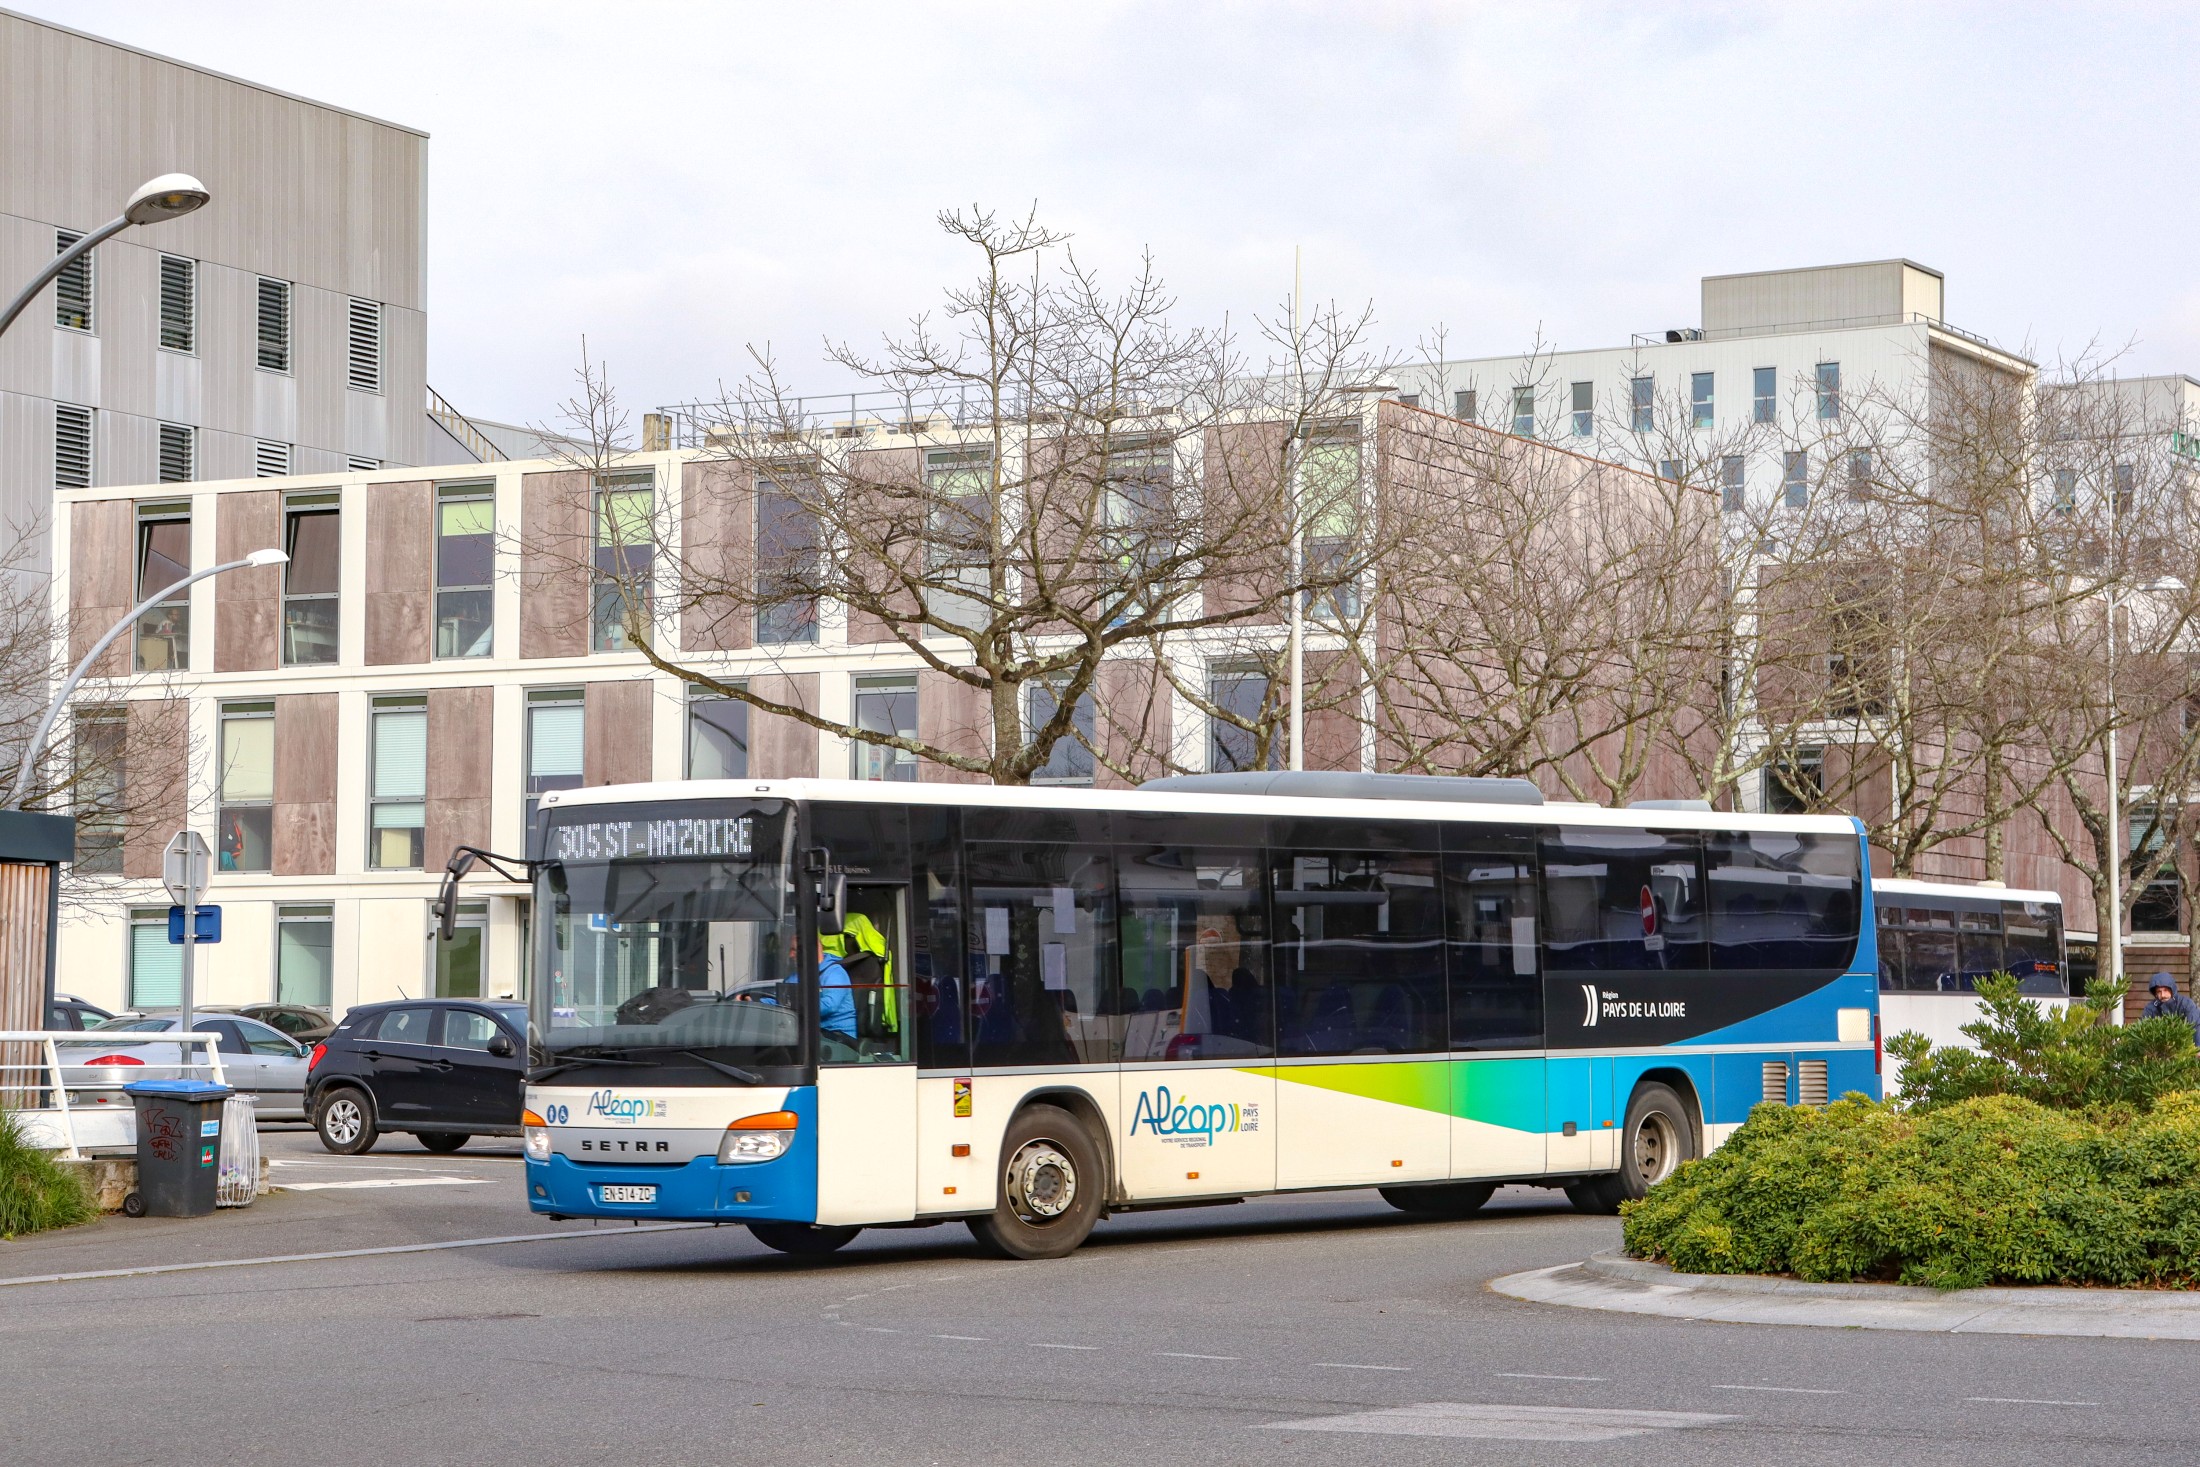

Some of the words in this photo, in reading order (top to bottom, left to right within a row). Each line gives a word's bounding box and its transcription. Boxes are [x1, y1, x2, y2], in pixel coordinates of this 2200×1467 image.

[558, 822, 601, 860] 305
[1602, 991, 1619, 1000] Région
[1602, 1002, 1627, 1018] PAYS
[1629, 1002, 1642, 1018] DE
[1644, 1002, 1657, 1018] LA
[1659, 1002, 1686, 1018] LOIRE
[1243, 1108, 1259, 1117] PAYS
[1240, 1122, 1259, 1132] LOIRE
[581, 1140, 669, 1152] SETRA
